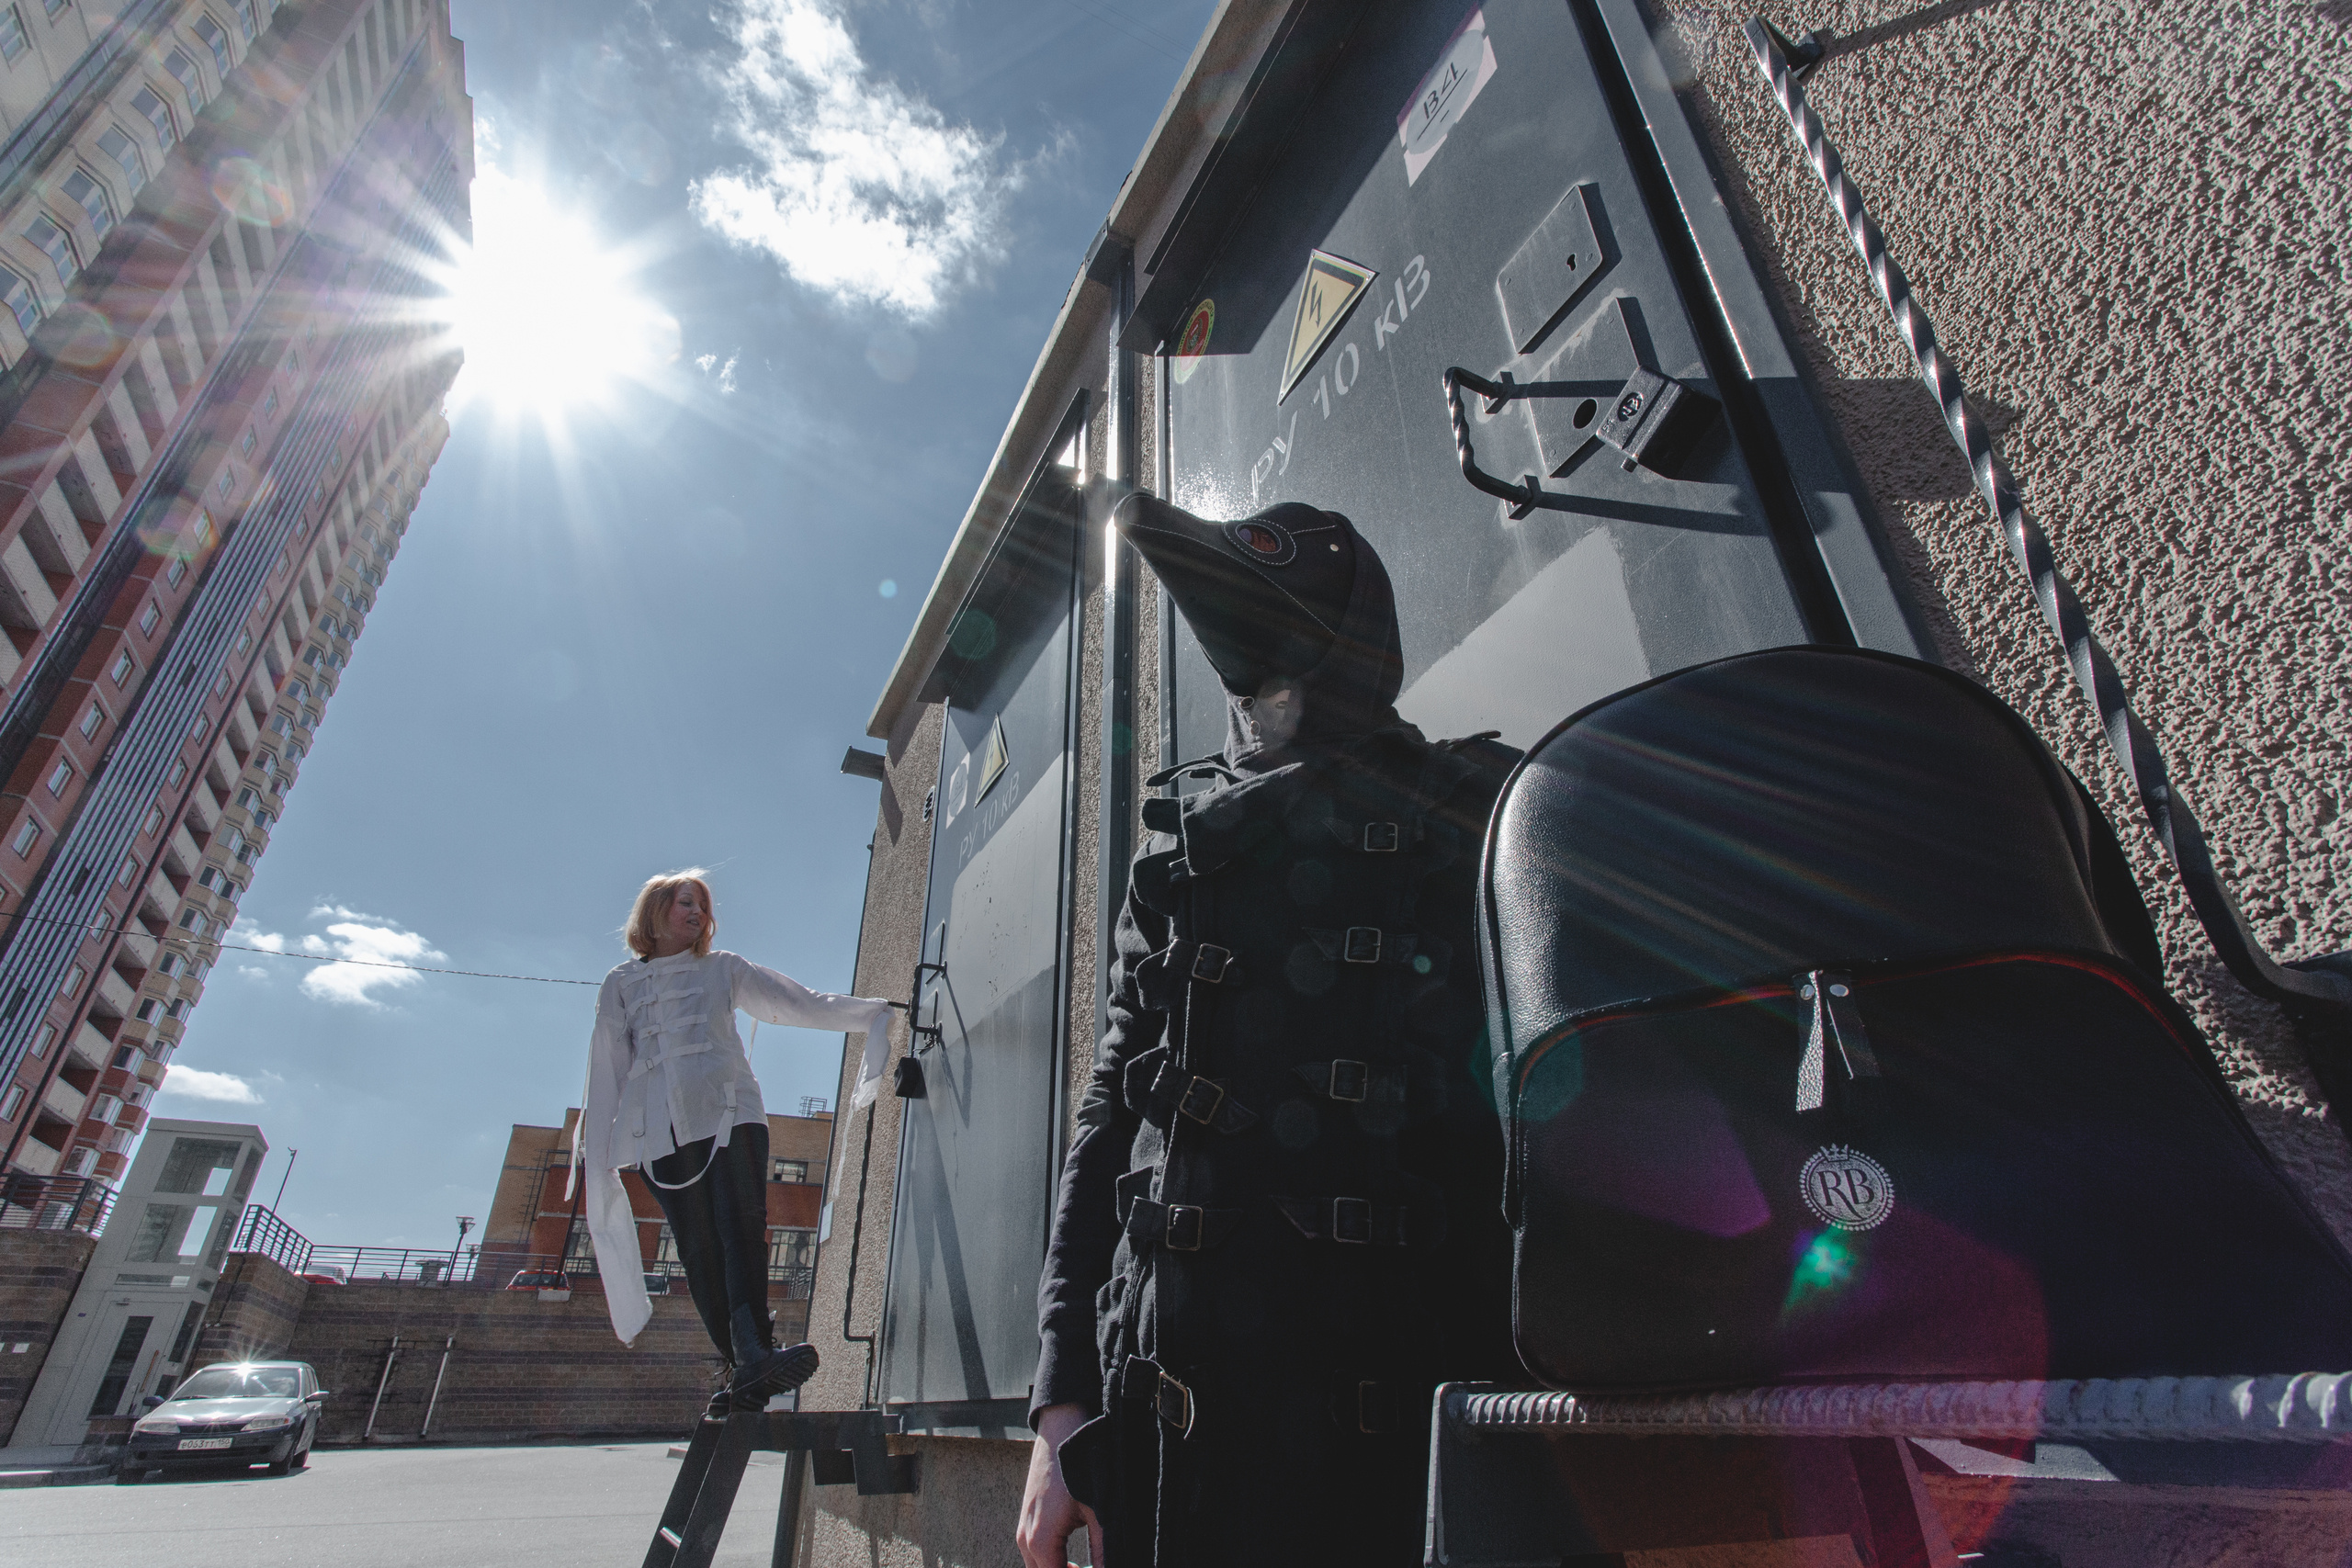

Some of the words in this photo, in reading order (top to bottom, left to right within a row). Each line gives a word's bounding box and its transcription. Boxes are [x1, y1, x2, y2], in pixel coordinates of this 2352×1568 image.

[1311, 343, 1360, 420] 10
[982, 798, 998, 840] 10
[1816, 1168, 1875, 1219] RB
